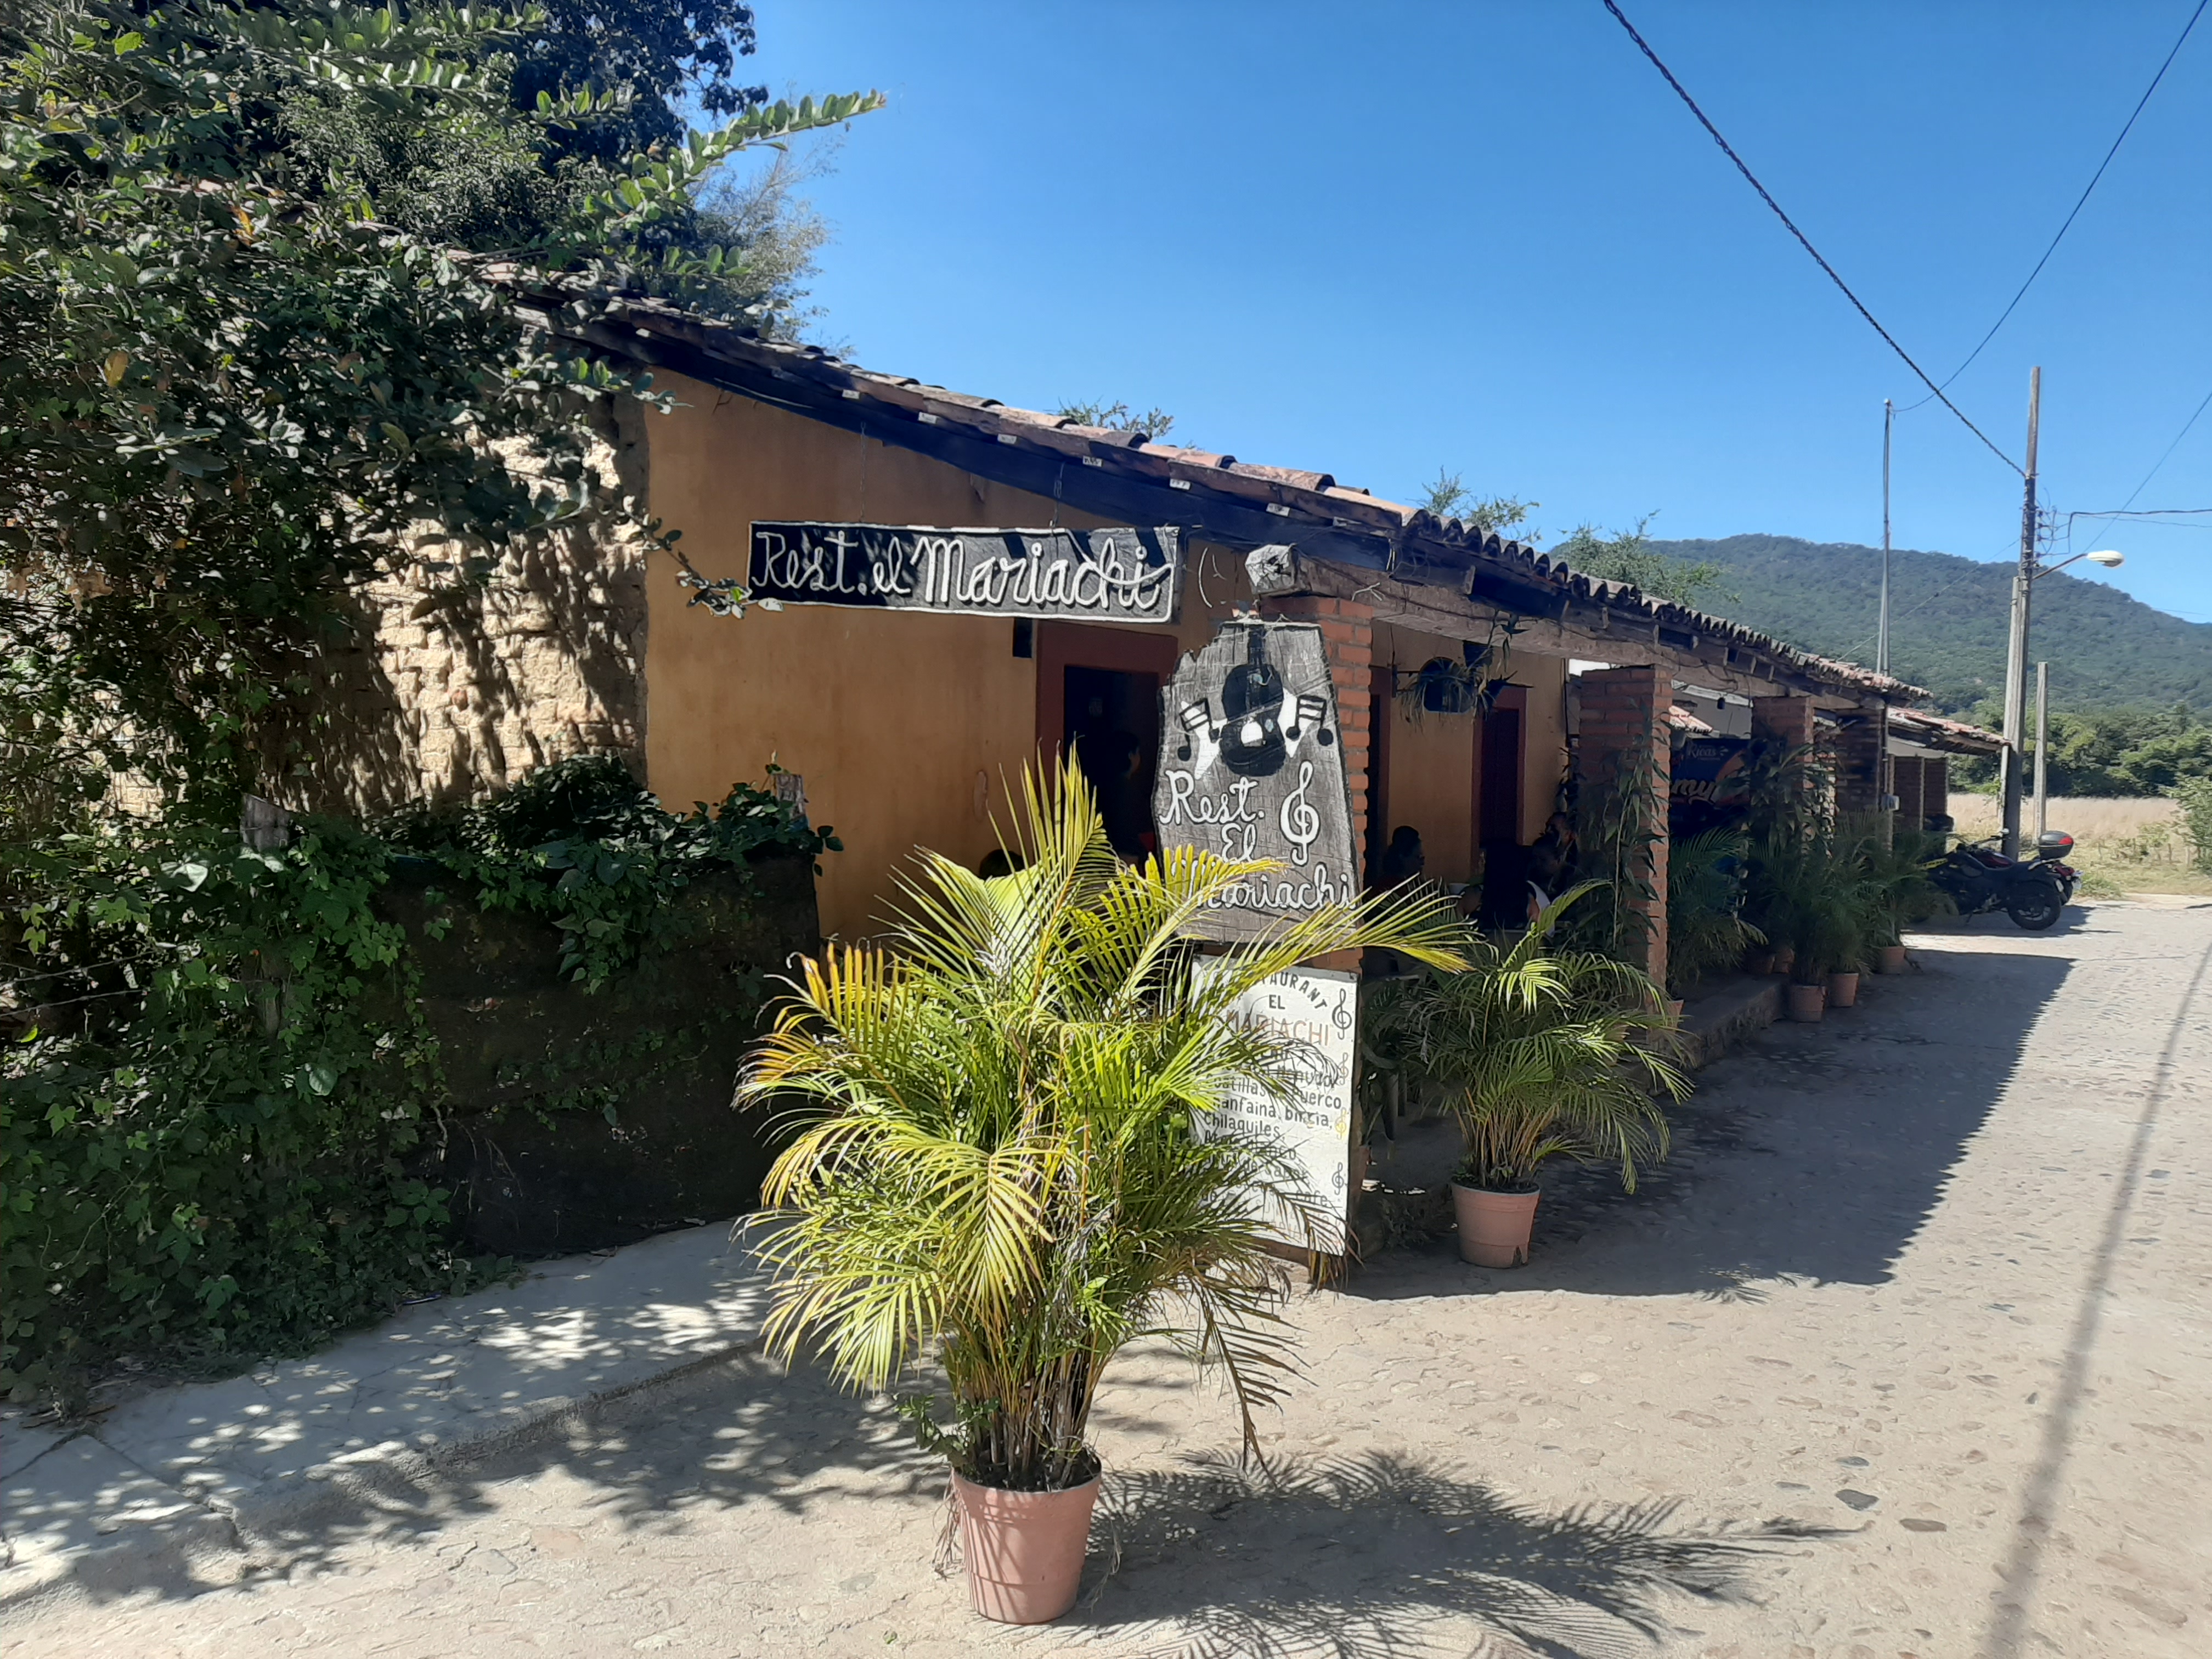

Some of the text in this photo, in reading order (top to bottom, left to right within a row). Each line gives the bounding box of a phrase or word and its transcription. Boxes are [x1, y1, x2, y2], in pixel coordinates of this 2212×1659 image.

[751, 529, 867, 595] Rest.
[909, 535, 1173, 610] Mariachi
[1159, 769, 1265, 825] Rest.
[1220, 822, 1257, 864] El
[1268, 994, 1286, 1010] EL
[1226, 1009, 1329, 1046] MARIACHI
[1300, 1088, 1342, 1109] uerco
